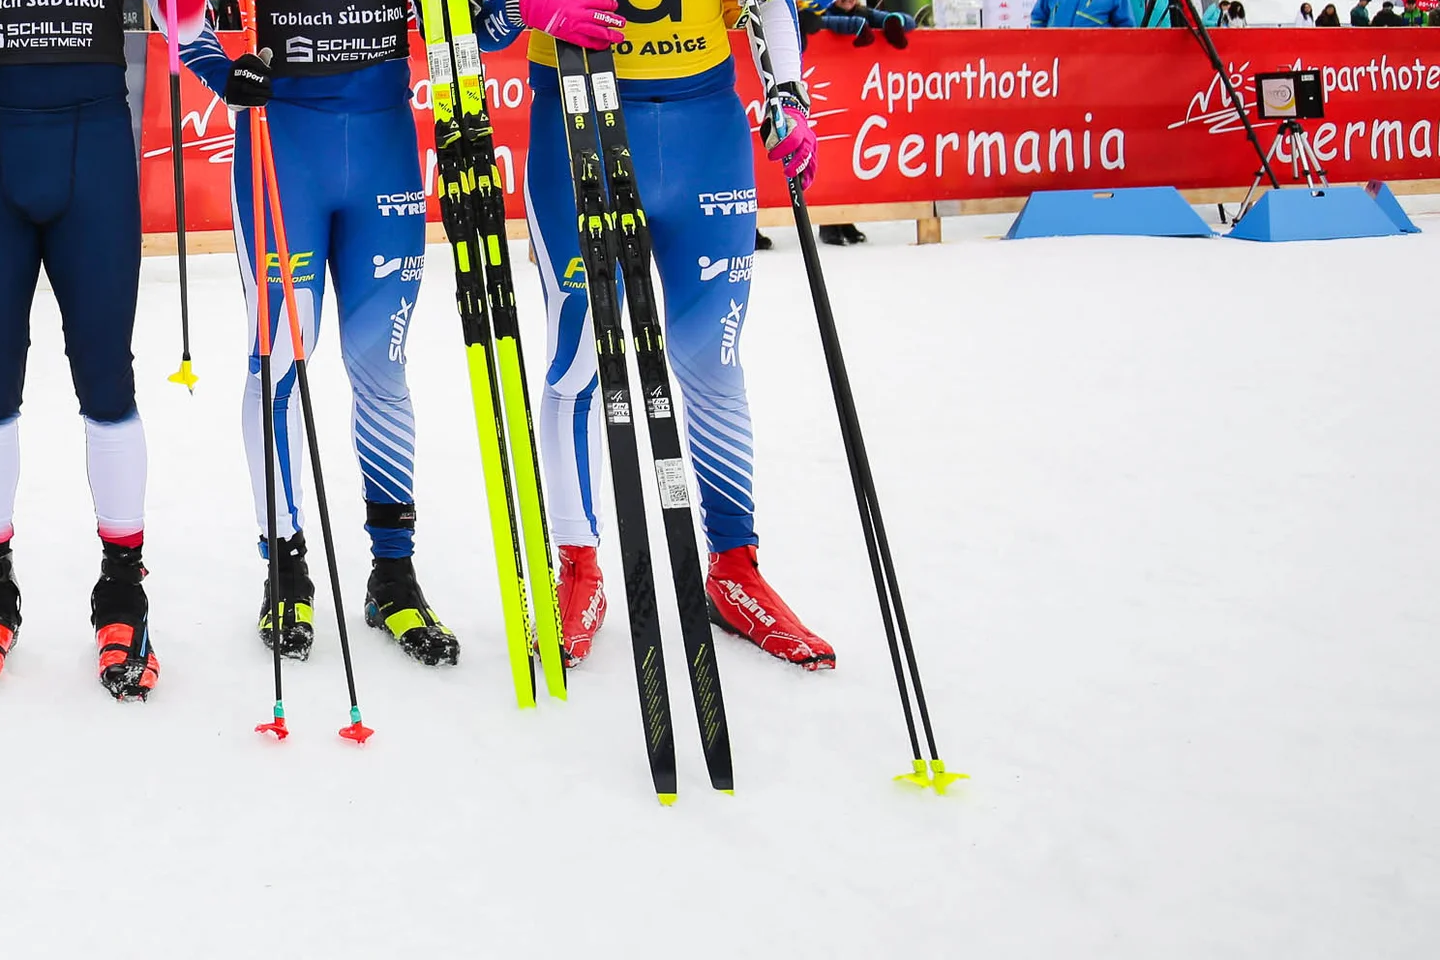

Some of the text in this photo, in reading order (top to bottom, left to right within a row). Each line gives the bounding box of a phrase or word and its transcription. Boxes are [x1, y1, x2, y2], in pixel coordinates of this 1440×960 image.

[270, 11, 333, 26] Toblach
[7, 21, 94, 36] SCHILLER
[7, 37, 94, 49] INVESTMENT
[317, 34, 398, 52] SCHILLER
[860, 56, 1060, 113] Apparthotel
[852, 112, 1126, 182] Germania
[719, 578, 778, 628] alpina
